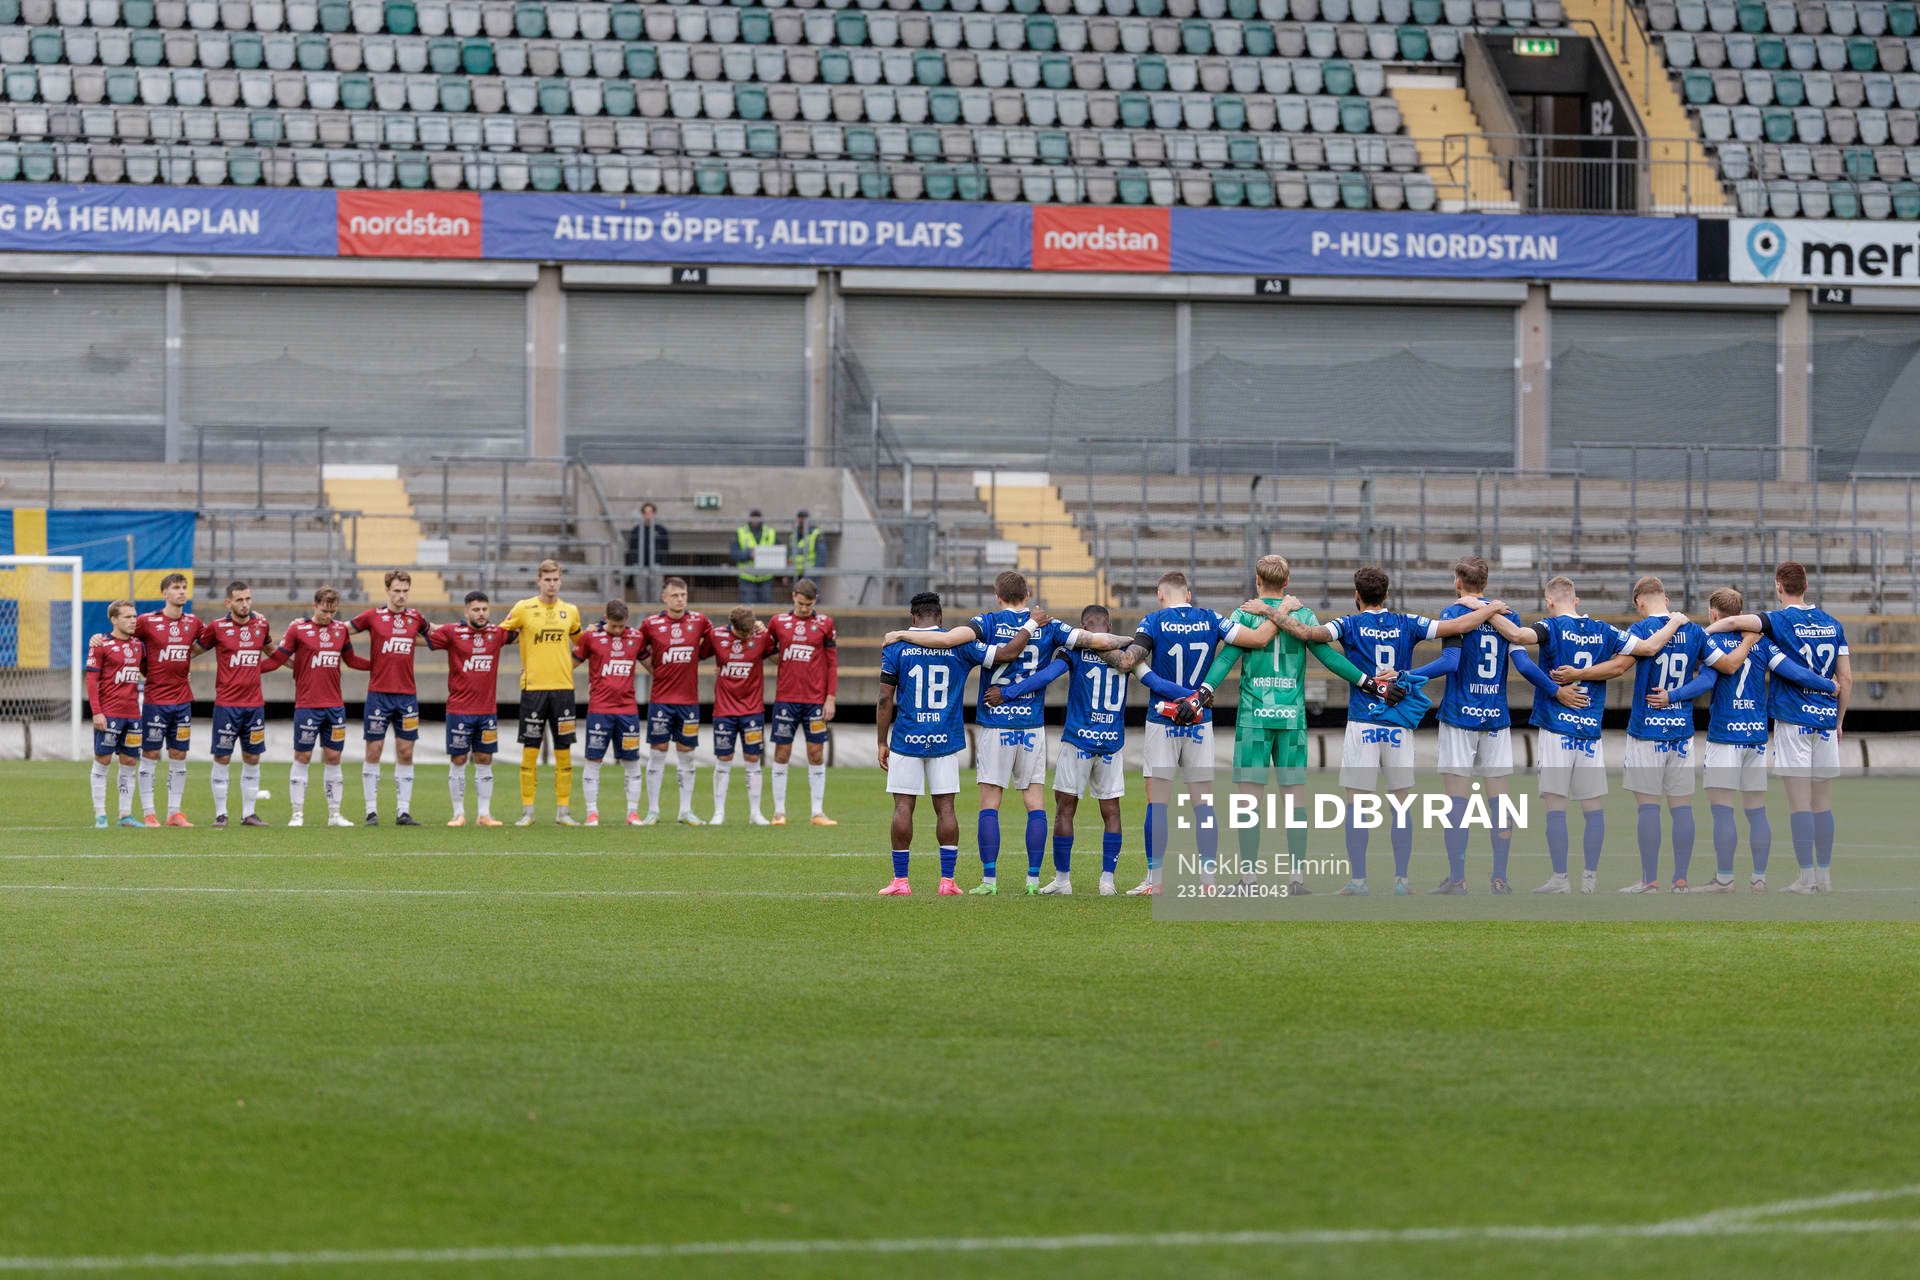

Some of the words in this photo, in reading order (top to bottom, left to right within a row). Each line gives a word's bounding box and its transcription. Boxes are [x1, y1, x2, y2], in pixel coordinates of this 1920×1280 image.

[1591, 100, 1613, 135] B2
[24, 196, 63, 232] PÅ
[69, 205, 260, 235] HEMMAPLAN
[350, 209, 470, 237] nordstan
[553, 214, 654, 241] ALLTID
[660, 211, 765, 249] ÖPPET,
[771, 219, 870, 246] ALLTID
[876, 221, 964, 248] PLATS
[1044, 224, 1159, 252] nordstan
[1311, 230, 1400, 259] P-HUS
[1406, 232, 1558, 260] NORDSTAN
[1802, 230, 1920, 277] mer
[1161, 621, 1210, 634] Kappahl
[382, 637, 413, 653] NTEX
[534, 629, 565, 645] NTEX
[1562, 630, 1603, 646] Kappahl
[158, 645, 190, 662] NTEX
[229, 650, 260, 667] NTEX
[311, 651, 340, 668] NTEX
[662, 646, 694, 664] NTEX
[783, 644, 815, 662] NTEX
[902, 648, 922, 656] AROS
[923, 648, 954, 656] KAPITAL
[1477, 635, 1498, 679] 3
[463, 655, 493, 672] NTEX
[601, 660, 633, 677] NTEX
[721, 662, 753, 678] NTEX
[1168, 642, 1209, 687] 17
[1655, 653, 1688, 692] 19
[908, 664, 950, 709] 18
[1086, 666, 1126, 711] 10
